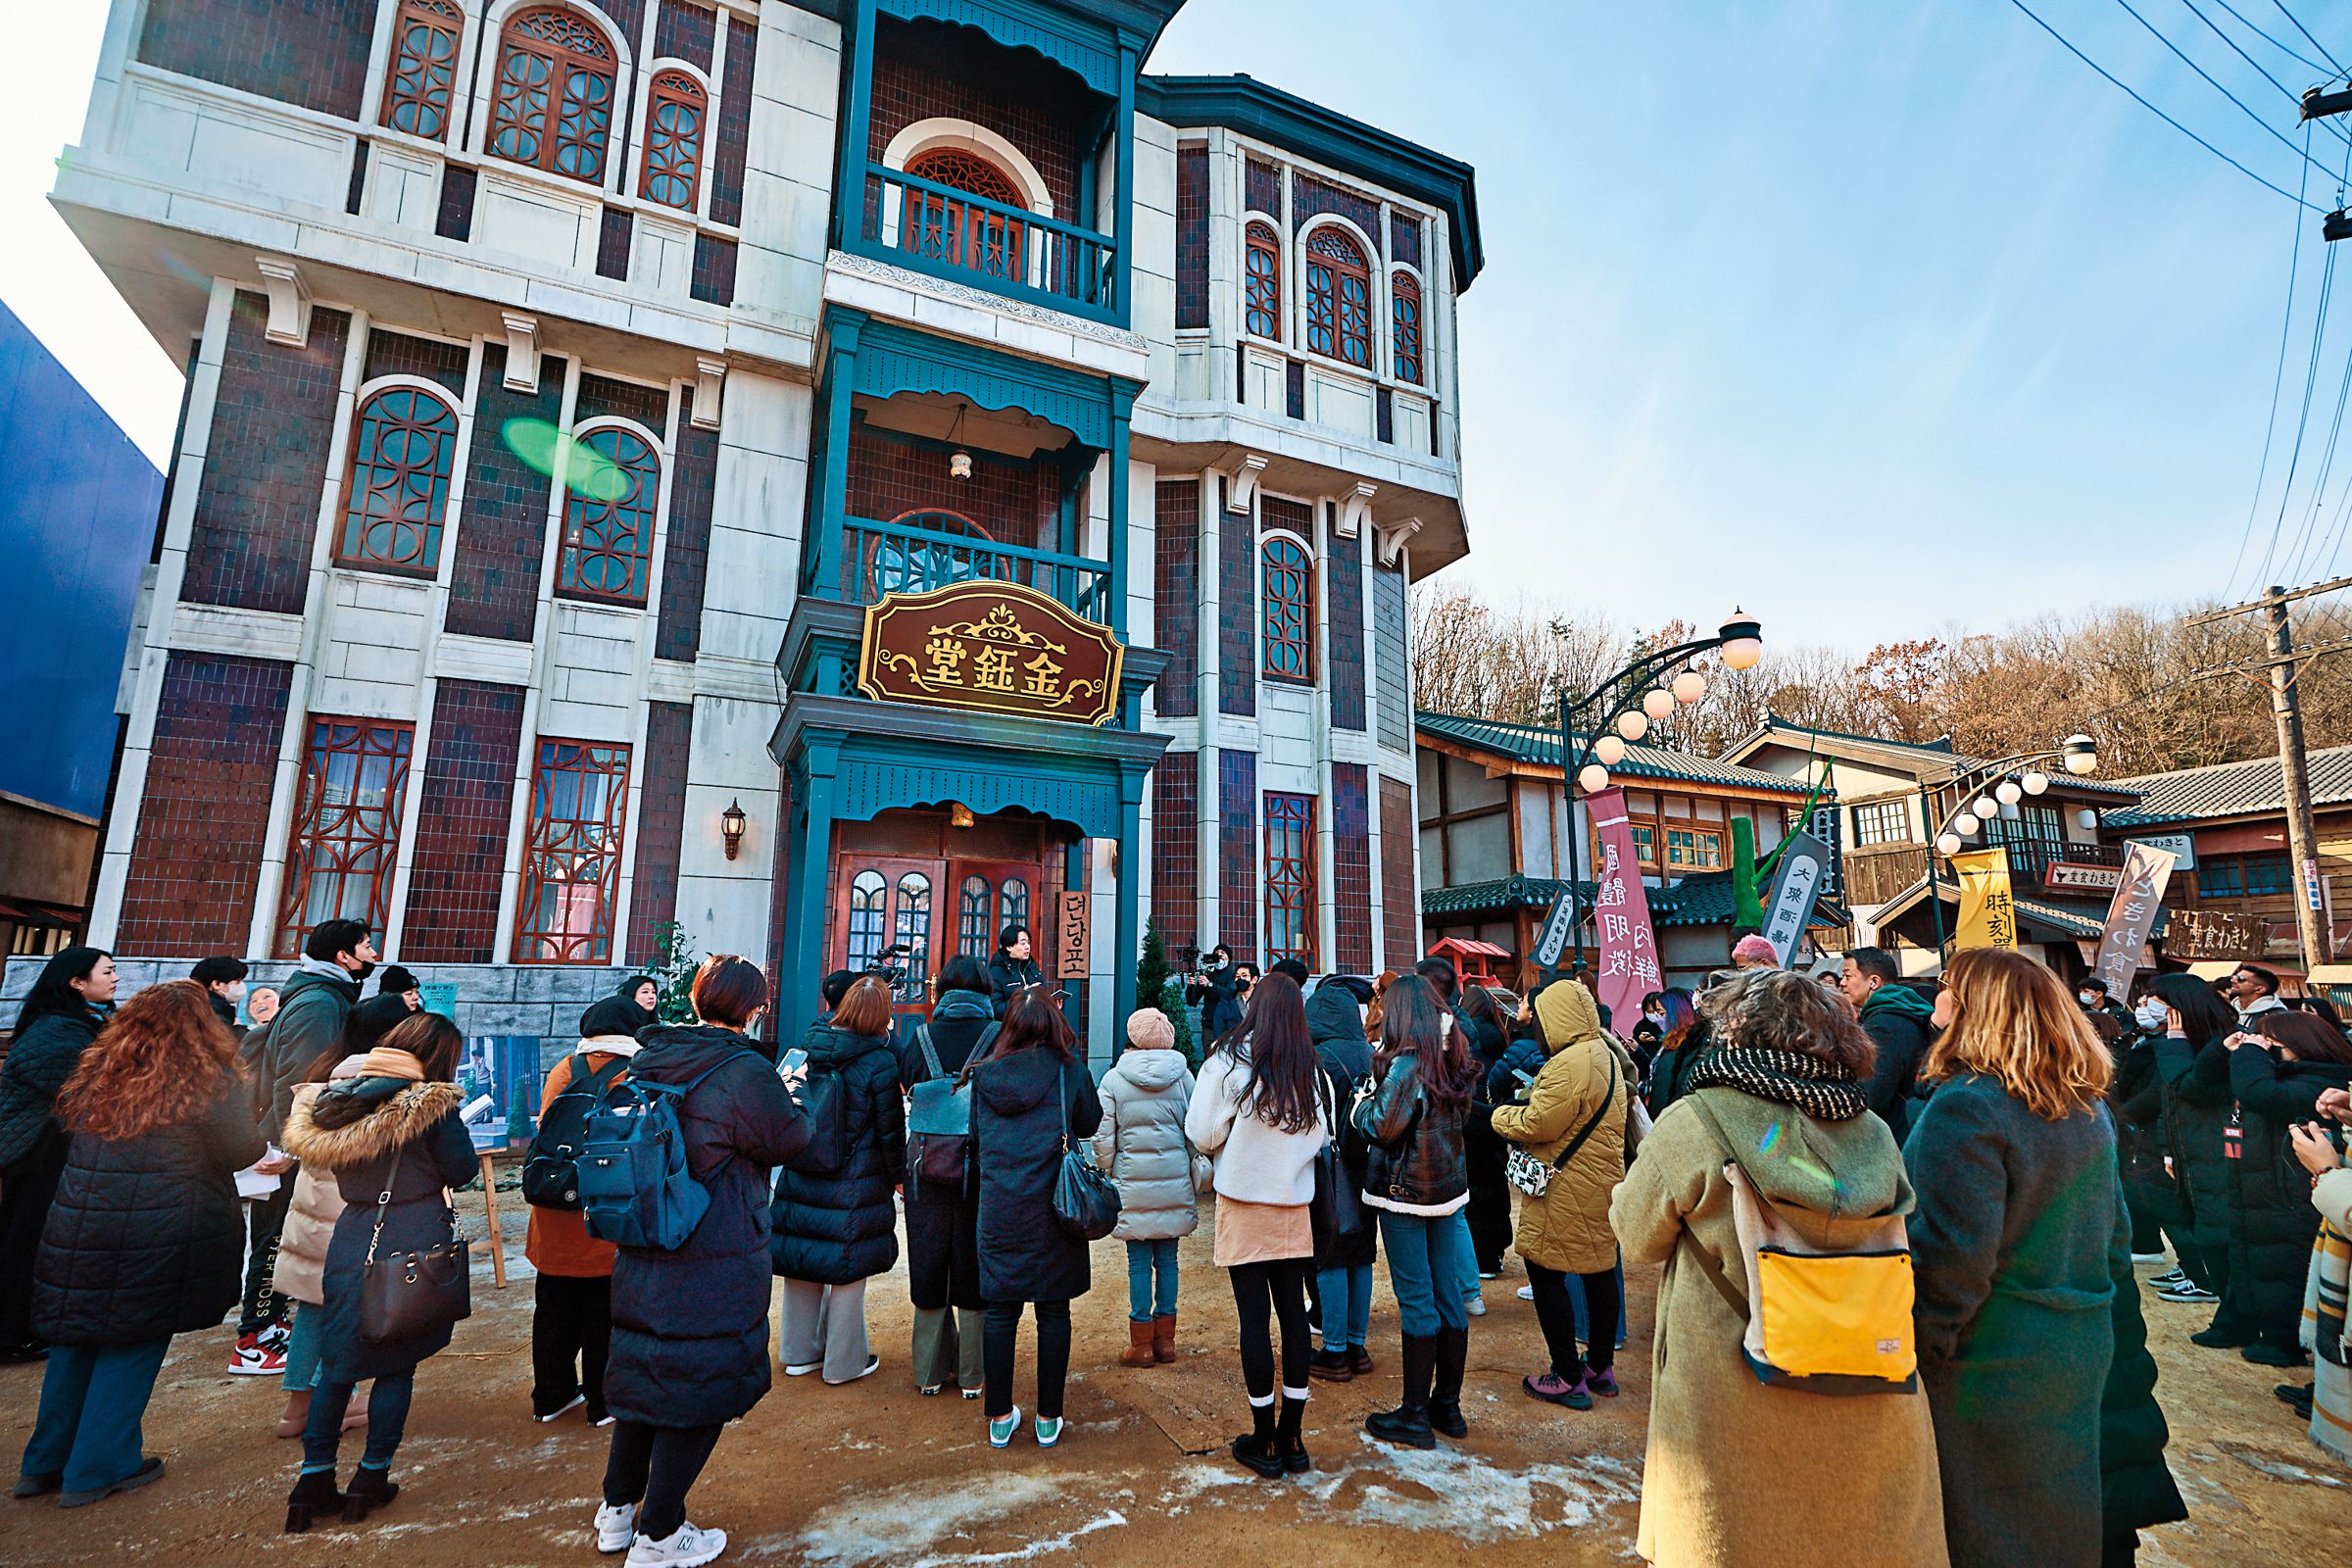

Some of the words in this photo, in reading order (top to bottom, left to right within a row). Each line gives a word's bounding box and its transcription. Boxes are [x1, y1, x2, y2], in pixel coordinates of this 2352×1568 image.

[1064, 895, 1087, 974] 뎐당포
[265, 1235, 282, 1271] PYER
[256, 1277, 273, 1318] MOSS
